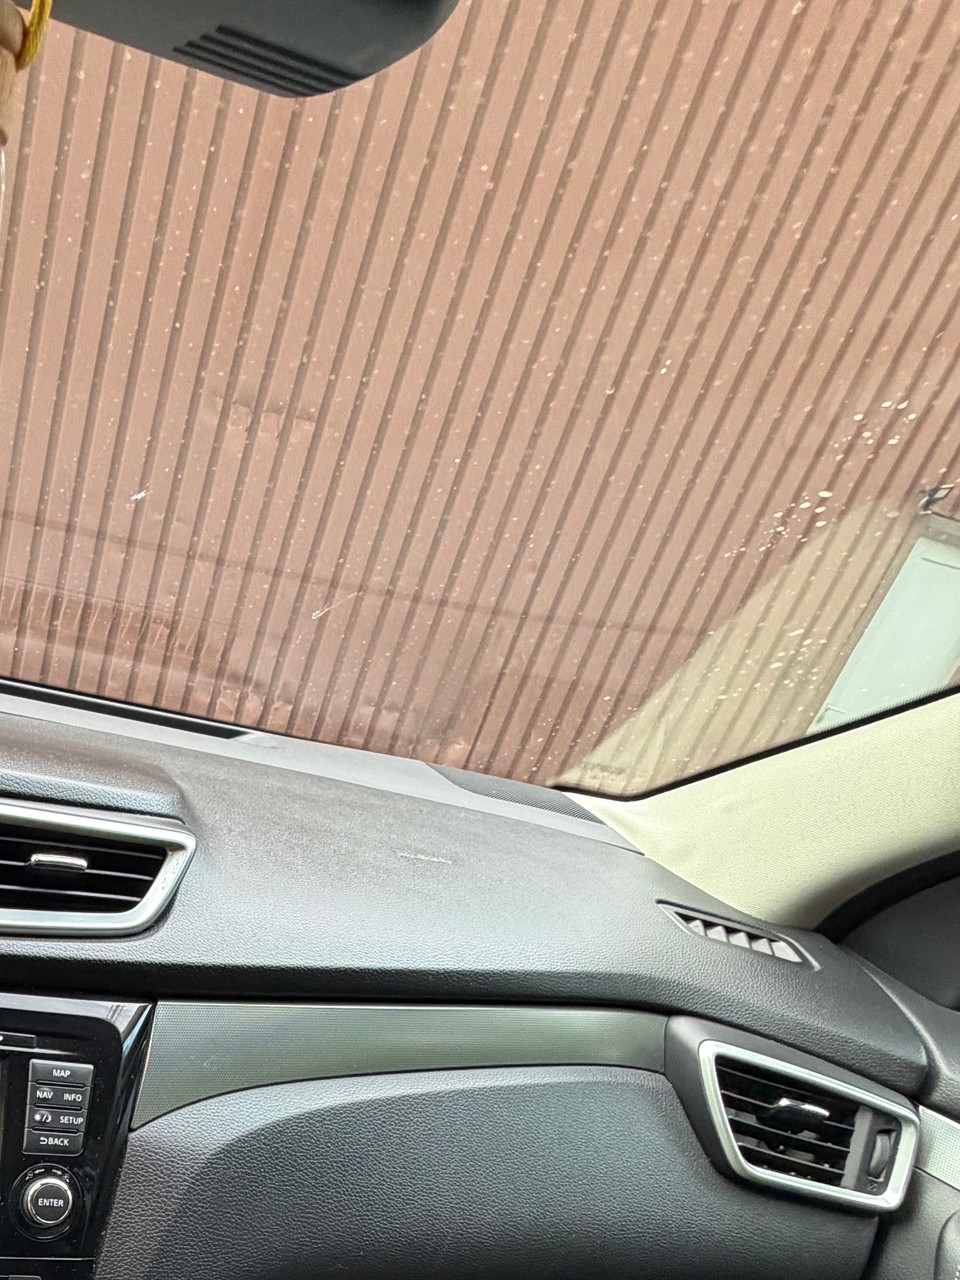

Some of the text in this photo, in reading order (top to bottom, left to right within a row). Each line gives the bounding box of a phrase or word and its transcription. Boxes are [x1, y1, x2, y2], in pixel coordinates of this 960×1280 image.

[52, 1068, 71, 1078] MAP
[36, 1090, 54, 1100] NAV
[63, 1093, 83, 1102] INFO
[59, 1115, 84, 1125] SETUP
[48, 1137, 70, 1147] BACK
[38, 1198, 64, 1207] ENTER
